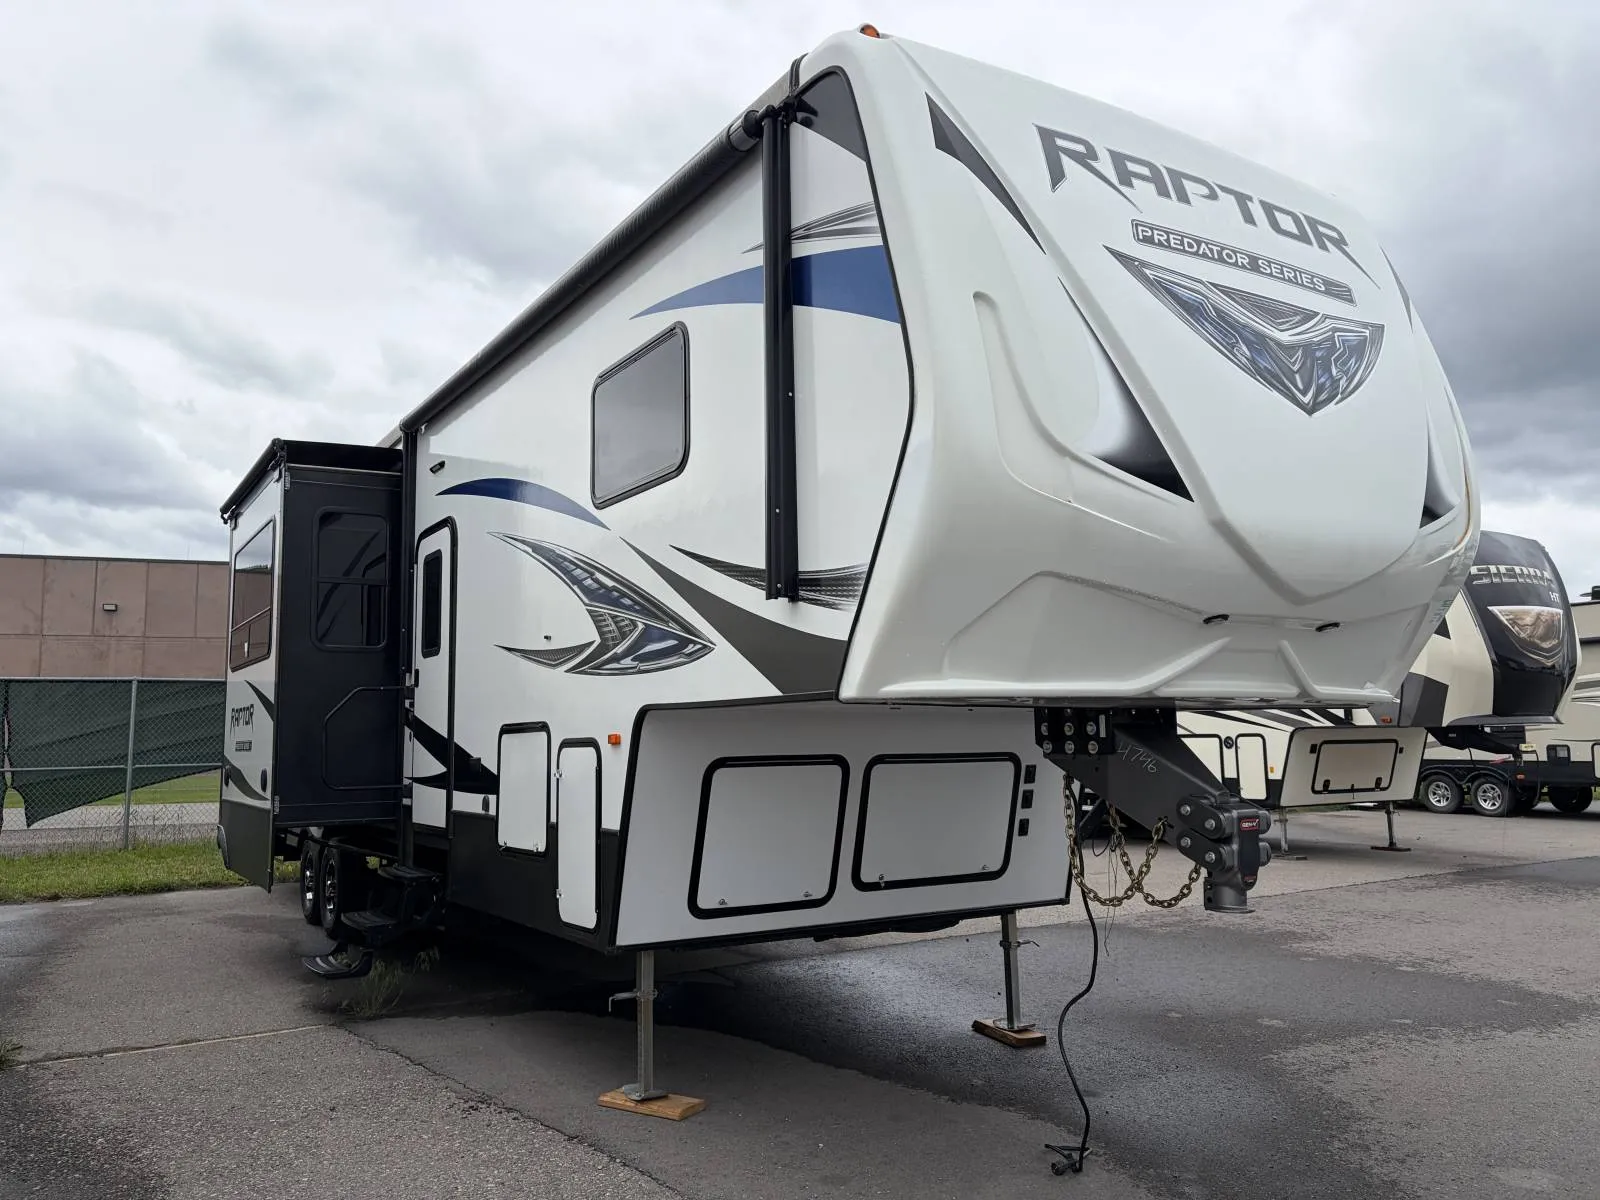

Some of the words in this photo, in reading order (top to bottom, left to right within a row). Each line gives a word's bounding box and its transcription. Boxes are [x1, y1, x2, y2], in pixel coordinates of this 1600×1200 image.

[1032, 123, 1381, 290] RAPTOR
[1136, 225, 1251, 269] PREDATOR
[1257, 258, 1326, 291] SERIES
[1470, 564, 1556, 587] SIERRA
[230, 704, 254, 737] RAPTOR
